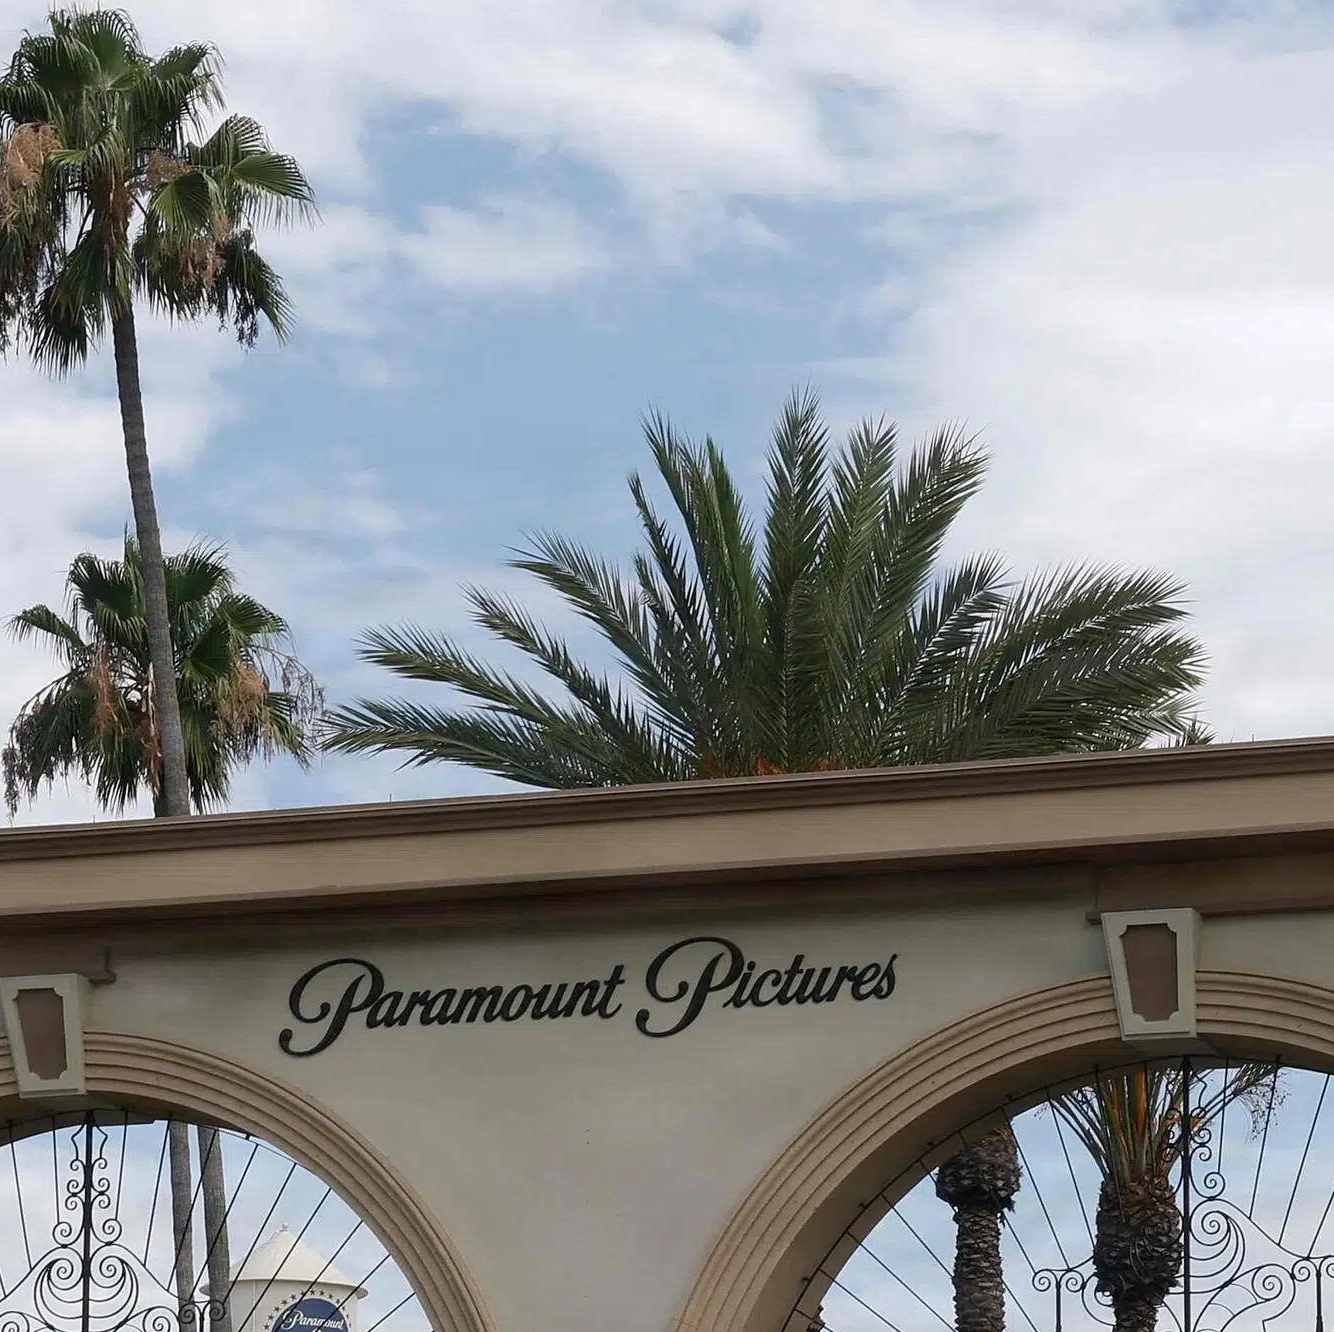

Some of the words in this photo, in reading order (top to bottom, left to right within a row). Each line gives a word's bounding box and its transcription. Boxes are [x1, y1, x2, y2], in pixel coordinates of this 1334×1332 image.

[278, 958, 625, 1057] Paramount
[635, 936, 897, 1038] Pictures
[281, 1309, 344, 1330] Paramount
